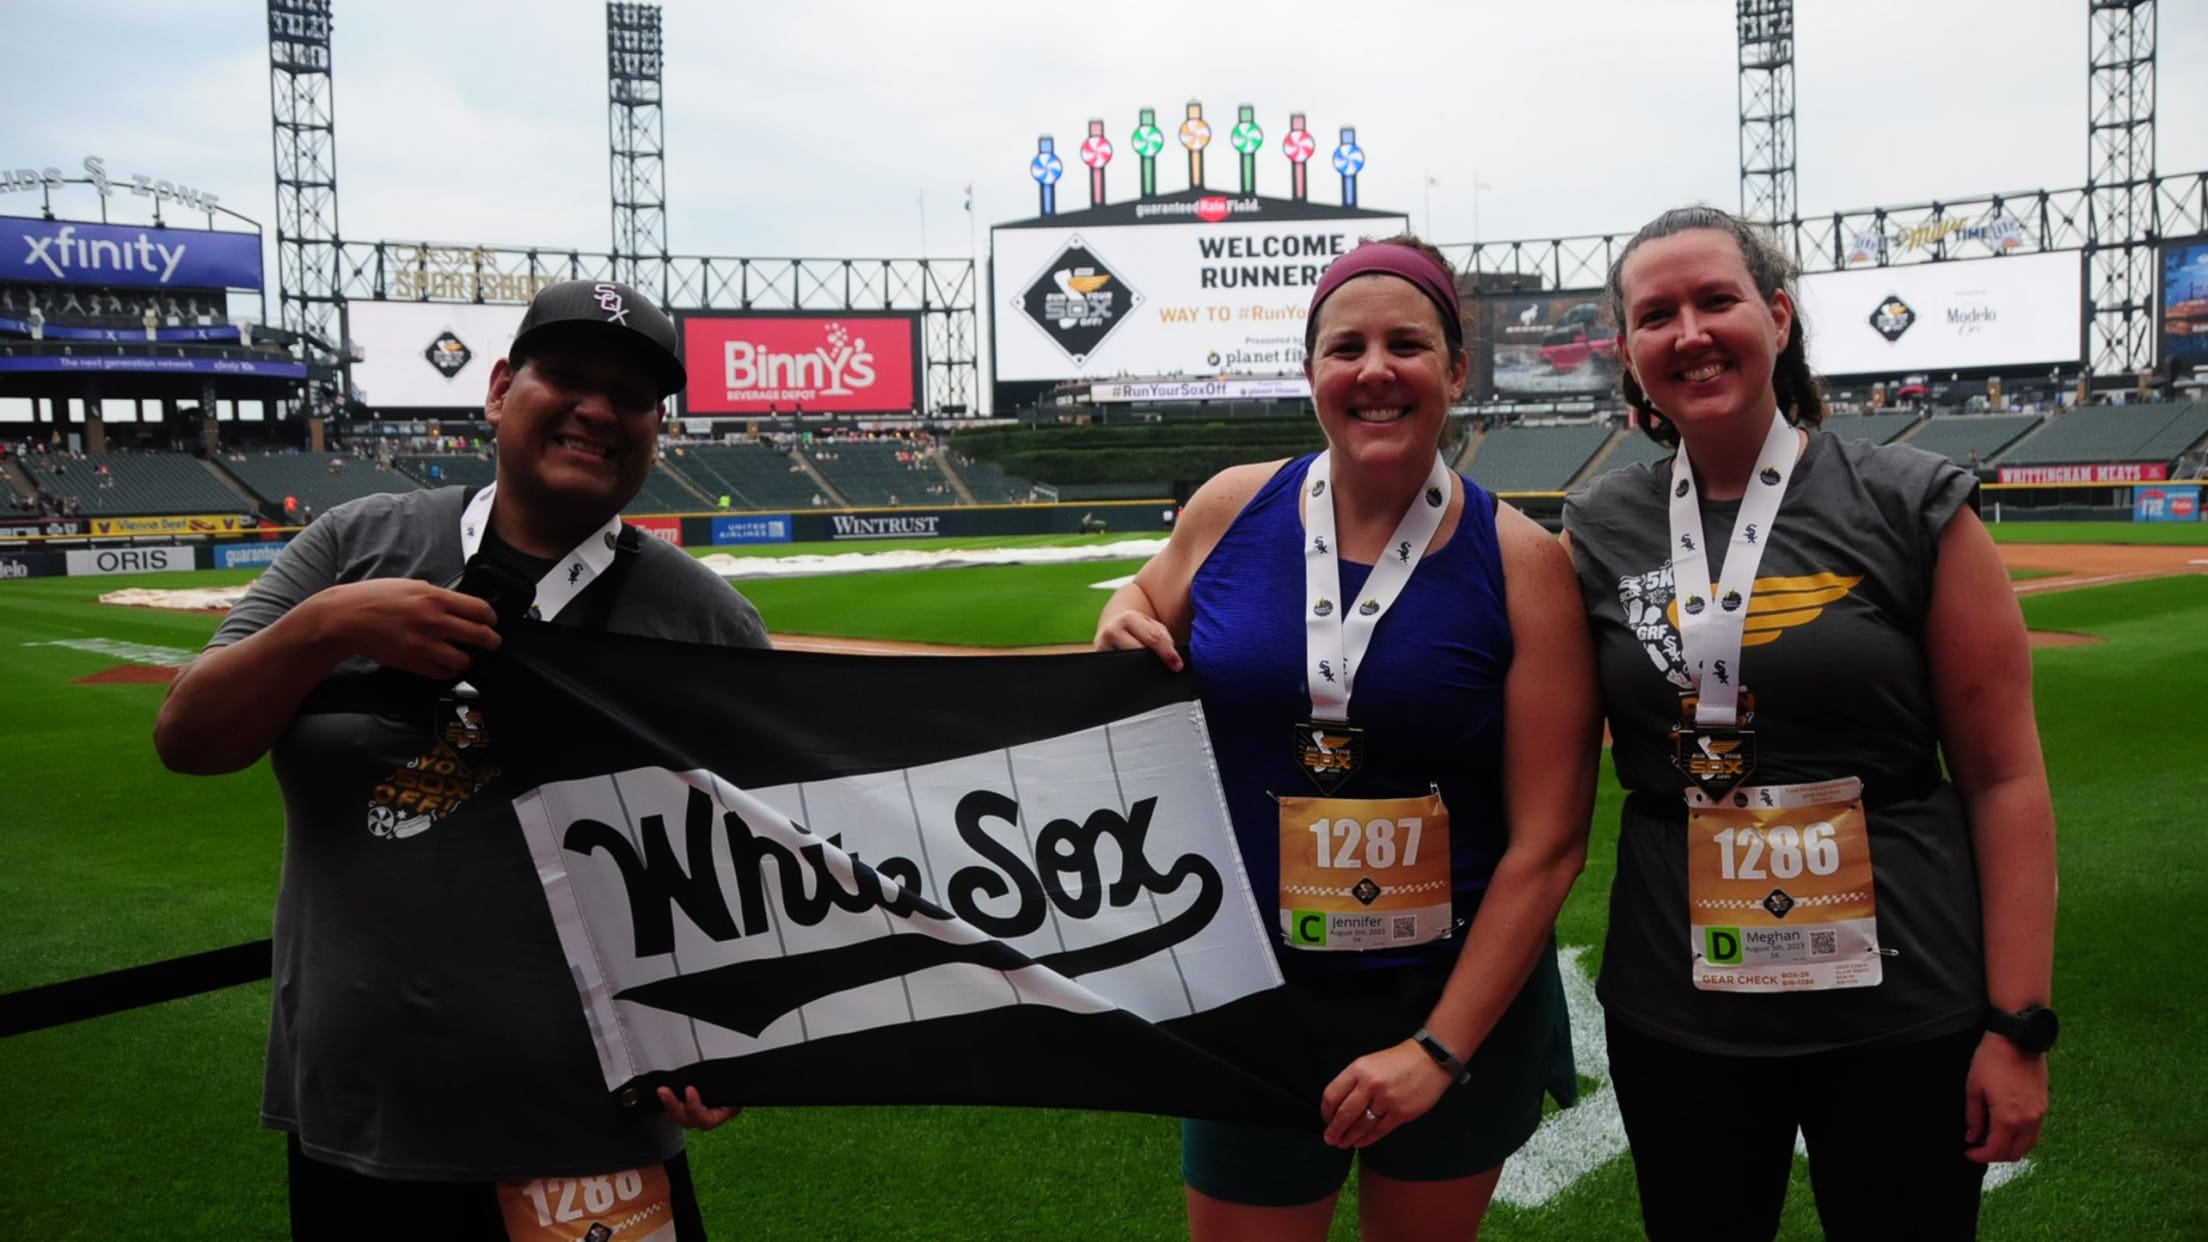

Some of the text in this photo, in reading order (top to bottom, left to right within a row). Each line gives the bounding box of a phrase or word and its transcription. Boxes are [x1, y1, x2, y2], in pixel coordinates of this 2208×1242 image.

[131, 174, 219, 215] ZONE
[1136, 202, 1198, 218] guaranteed
[23, 227, 186, 283] xfinity
[1199, 233, 1345, 259] WELCOME
[396, 270, 566, 302] SPORTSBOO
[1045, 299, 1112, 319] SOX
[1160, 307, 1199, 323] WAY
[1206, 306, 1231, 322] TO
[1946, 307, 1996, 323] Modelo
[60, 358, 77, 367] The
[1226, 349, 1279, 367] planet
[727, 390, 817, 401] BEVERAGE DEPOT
[1112, 382, 1226, 397] #RunYourSoxOff
[2002, 466, 2091, 484] WHITTINGHAM
[2098, 464, 2141, 482] MEATS
[119, 517, 187, 530] Vienna Beef
[728, 522, 768, 531] UNITED
[833, 516, 939, 535] WINTRUST
[719, 529, 768, 538] AIRLINES
[97, 551, 168, 572] ORIS
[1636, 624, 1668, 640] GRF
[1309, 817, 1422, 869] 1287
[1713, 821, 1840, 880] 1286
[563, 785, 1223, 958] White Sox
[1300, 915, 1321, 942] C
[1332, 916, 1383, 929] Jennifer
[1711, 931, 1737, 960] D
[1746, 930, 1801, 945] Meghan
[1702, 974, 1778, 985] GEAR CHECK
